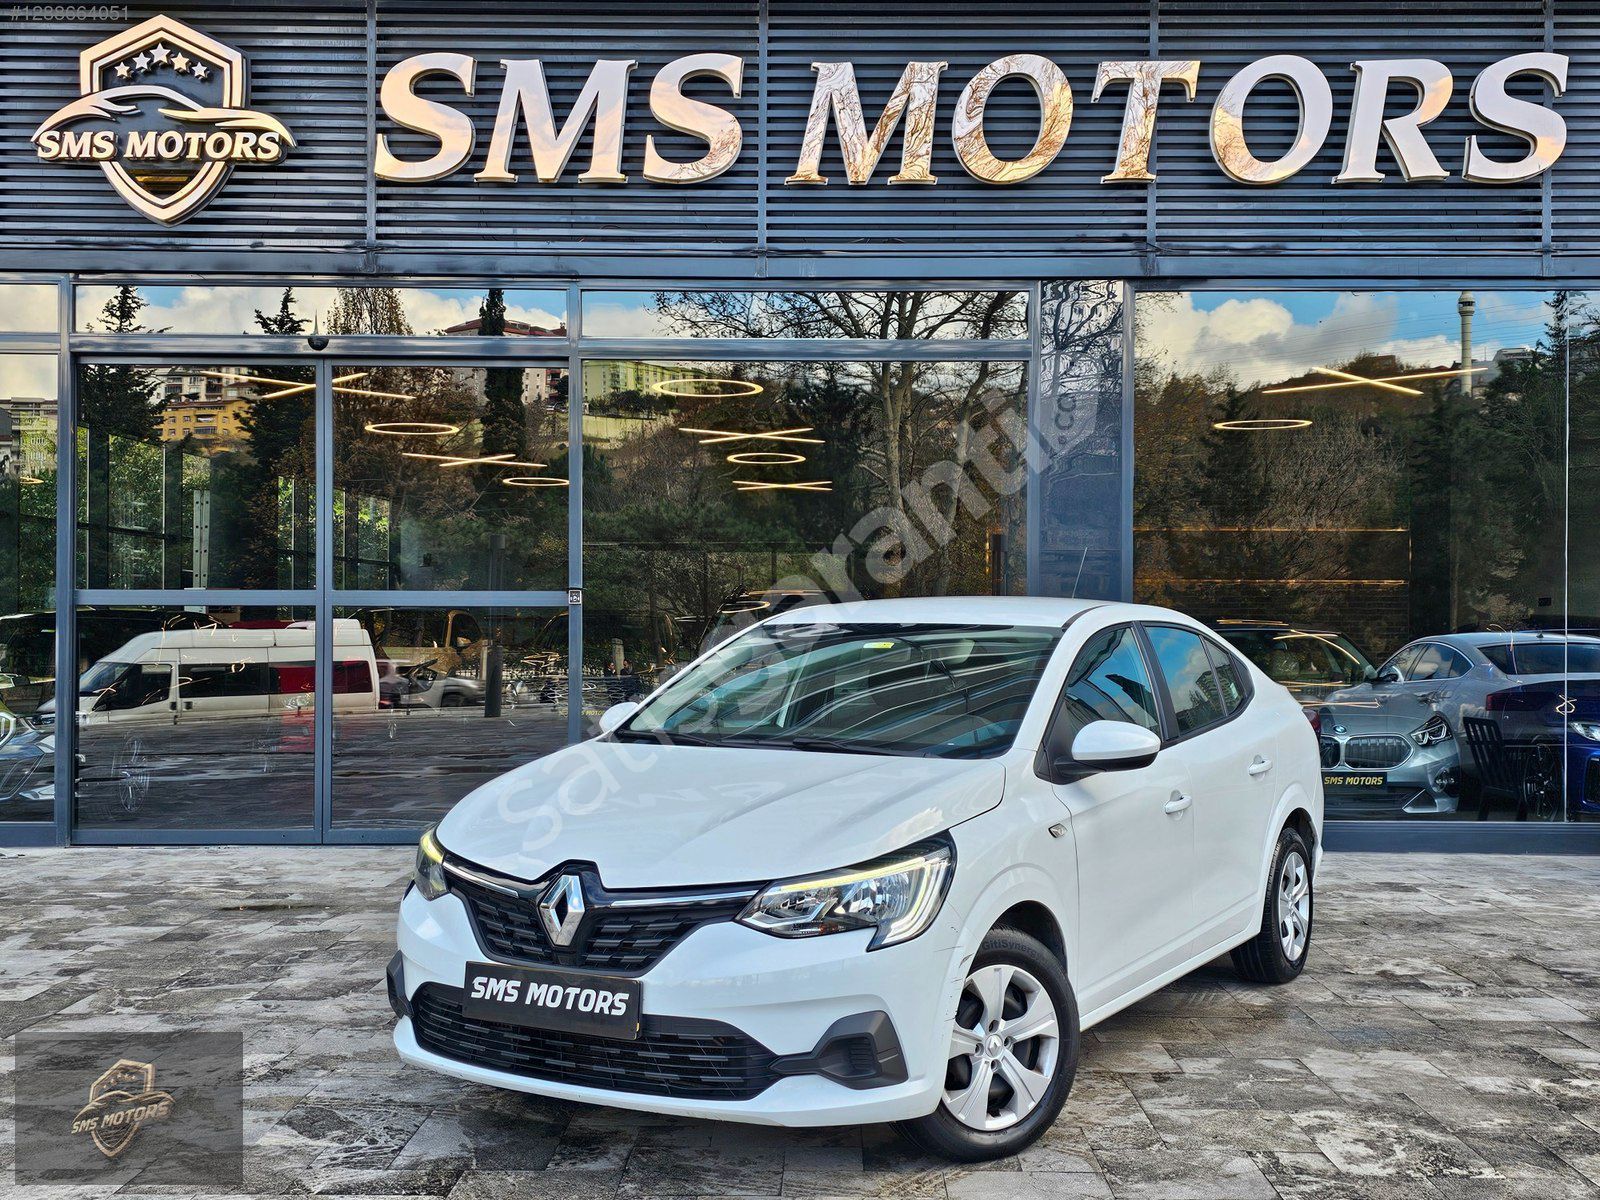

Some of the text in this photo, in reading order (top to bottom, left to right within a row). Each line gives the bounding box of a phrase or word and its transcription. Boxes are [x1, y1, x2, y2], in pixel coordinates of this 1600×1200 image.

[374, 52, 1570, 186] SMS MOTORS
[37, 130, 281, 161] SMS MOTORS
[1324, 776, 1383, 785] SMS MOTORS
[471, 976, 629, 1016] SMS MOTORS
